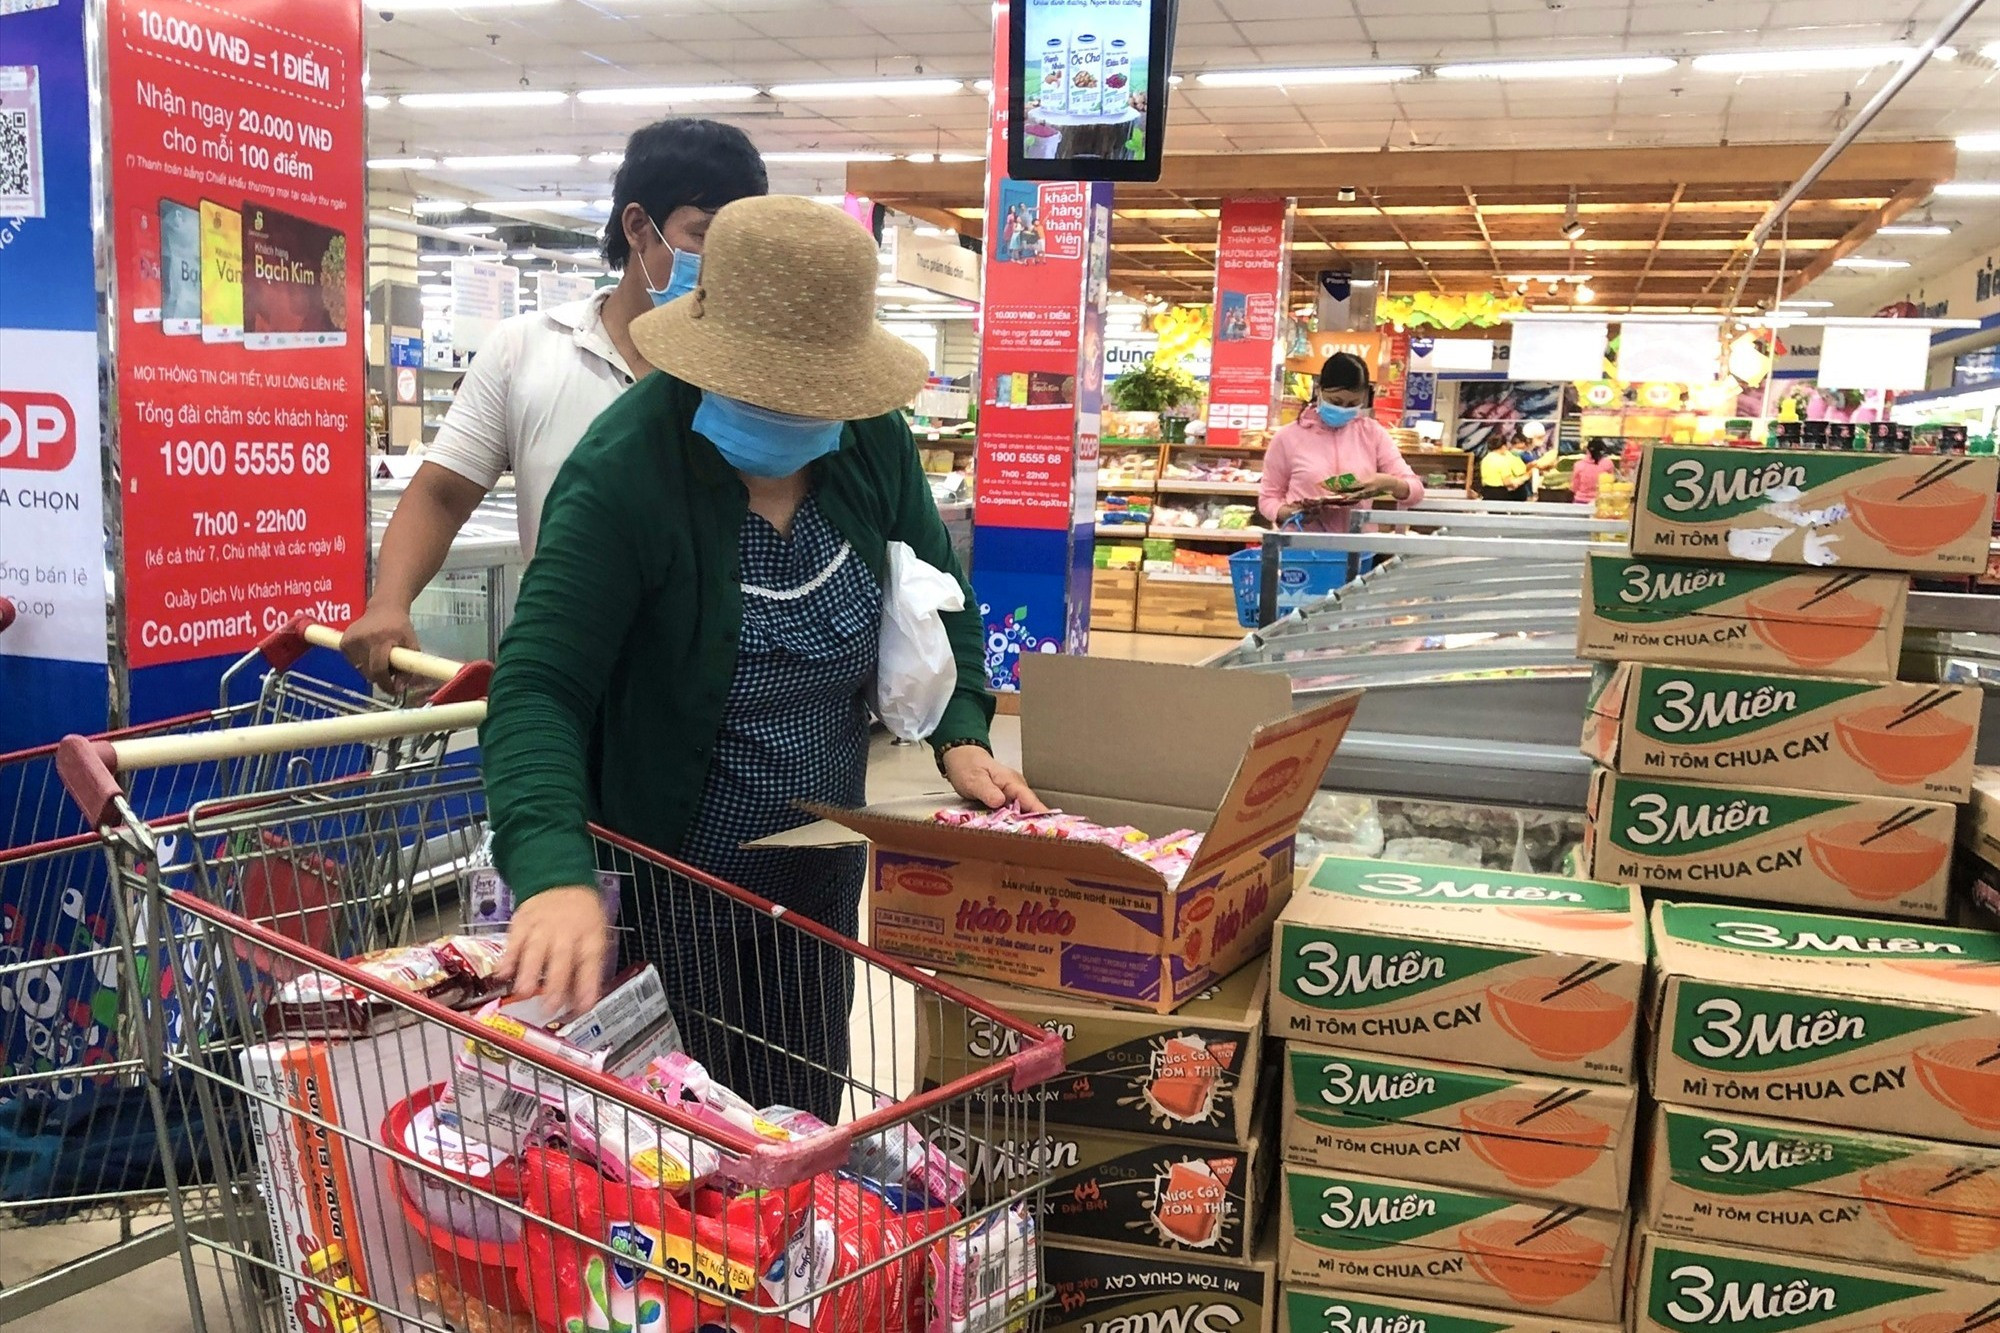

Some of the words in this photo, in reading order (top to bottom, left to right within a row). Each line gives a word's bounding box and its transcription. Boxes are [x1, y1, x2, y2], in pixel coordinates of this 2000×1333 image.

[138, 10, 203, 52] 10.000
[207, 28, 250, 67] VNĐ
[271, 50, 279, 76] 1
[283, 51, 330, 91] ĐIỂM
[136, 79, 186, 120] Nhận
[192, 99, 234, 133] ngay
[238, 107, 294, 142] 20.000
[298, 122, 333, 152] VNĐ
[162, 127, 197, 154] cho
[202, 133, 234, 163] mỗi
[239, 144, 269, 170] 100
[273, 150, 314, 181] điểm
[1044, 192, 1084, 204] khách
[1051, 205, 1083, 219] hàng
[1045, 219, 1082, 231] thành
[255, 255, 289, 286] Bạch
[291, 259, 315, 286] Kim
[134, 366, 157, 383] MỌI
[159, 366, 198, 385] THÔNG
[201, 370, 217, 384] TIN
[219, 370, 238, 386] CHI
[265, 374, 281, 388] VUI
[283, 371, 309, 390] LÒNG
[311, 373, 331, 391] LIÊN
[135, 401, 174, 428] Tổng
[178, 402, 200, 425] đài
[204, 403, 243, 426] chăm
[246, 404, 271, 427] sóc
[274, 405, 313, 428] khách
[315, 407, 349, 430] hàng:
[160, 440, 226, 476] 1900
[234, 442, 295, 476] 5555
[301, 442, 331, 476] 68
[990, 452, 1016, 462] 1900
[1019, 453, 1045, 463] 5555
[1047, 454, 1062, 465] 68
[1001, 470, 1019, 479] 7h00
[18, 490, 80, 514] CHỌN
[193, 511, 238, 538] 7h00
[256, 508, 307, 534] 22h00
[1654, 531, 1675, 546] MÌ
[1681, 530, 1718, 546] TÔM
[145, 549, 163, 570] (kể
[167, 548, 182, 566] cả
[185, 545, 206, 565] thứ
[222, 541, 245, 561] Chủ
[248, 541, 272, 562] nhật
[274, 541, 286, 557] và
[288, 539, 306, 557] các
[309, 538, 331, 557] ngày
[36, 566, 67, 584] bán
[73, 567, 88, 586] lẻ
[165, 588, 198, 611] Quầy
[201, 585, 227, 607] Dịch
[230, 585, 245, 604] Vụ
[248, 580, 282, 599] Khách
[284, 578, 311, 599] Hàng
[313, 576, 332, 594] của
[142, 611, 258, 649] Co.opmart,
[1613, 631, 1629, 643] MÌ
[1630, 632, 1660, 647] TÔM
[1663, 632, 1709, 647] CHUA
[1713, 624, 1748, 643] CAY
[1645, 752, 1665, 767] MÌ
[1669, 752, 1709, 769] TÔM
[1714, 748, 1779, 769] CHUA
[1783, 731, 1830, 760] CAY
[1618, 862, 1639, 878] MÌ
[1643, 864, 1682, 880] TÔM
[1687, 861, 1752, 881] CHUA
[1756, 847, 1804, 873] CAY
[956, 895, 1013, 935] Hảo
[1016, 897, 1076, 937] Hảo
[1290, 1016, 1311, 1032] MÌ
[1316, 1018, 1356, 1036] TÔM
[1362, 1015, 1430, 1036] CHUA
[1433, 1002, 1482, 1030] CAY
[1107, 1050, 1145, 1063] GOLD
[1683, 1078, 1707, 1096] MÌ
[1713, 1080, 1759, 1100] TÔM
[1765, 1078, 1844, 1102] CHUA
[1850, 1066, 1907, 1096] CAY
[1315, 1134, 1333, 1148] MÌ
[1336, 1137, 1366, 1152] TÔM
[1370, 1140, 1420, 1156] CHUA
[1424, 1136, 1462, 1155] CAY
[1160, 1189, 1194, 1203] Nước
[1197, 1183, 1219, 1198] Cốt
[260, 1160, 275, 1215] NOODLES
[270, 1217, 286, 1268] INSTANT
[323, 1173, 345, 1239] PORK
[1163, 1202, 1194, 1216] TÔM
[1204, 1201, 1233, 1214] THỊT
[1692, 1201, 1712, 1215] MÌ
[1717, 1205, 1750, 1222] TÔM
[1756, 1209, 1814, 1226] CHUA
[1139, 1272, 1183, 1285] CHUA
[1318, 1259, 1335, 1272] MÌ
[1338, 1261, 1369, 1277] TÔM
[1373, 1262, 1423, 1278] CHUA
[1426, 1257, 1464, 1277] CAY
[1105, 1274, 1136, 1290] CAY
[1187, 1273, 1219, 1290] TÔM
